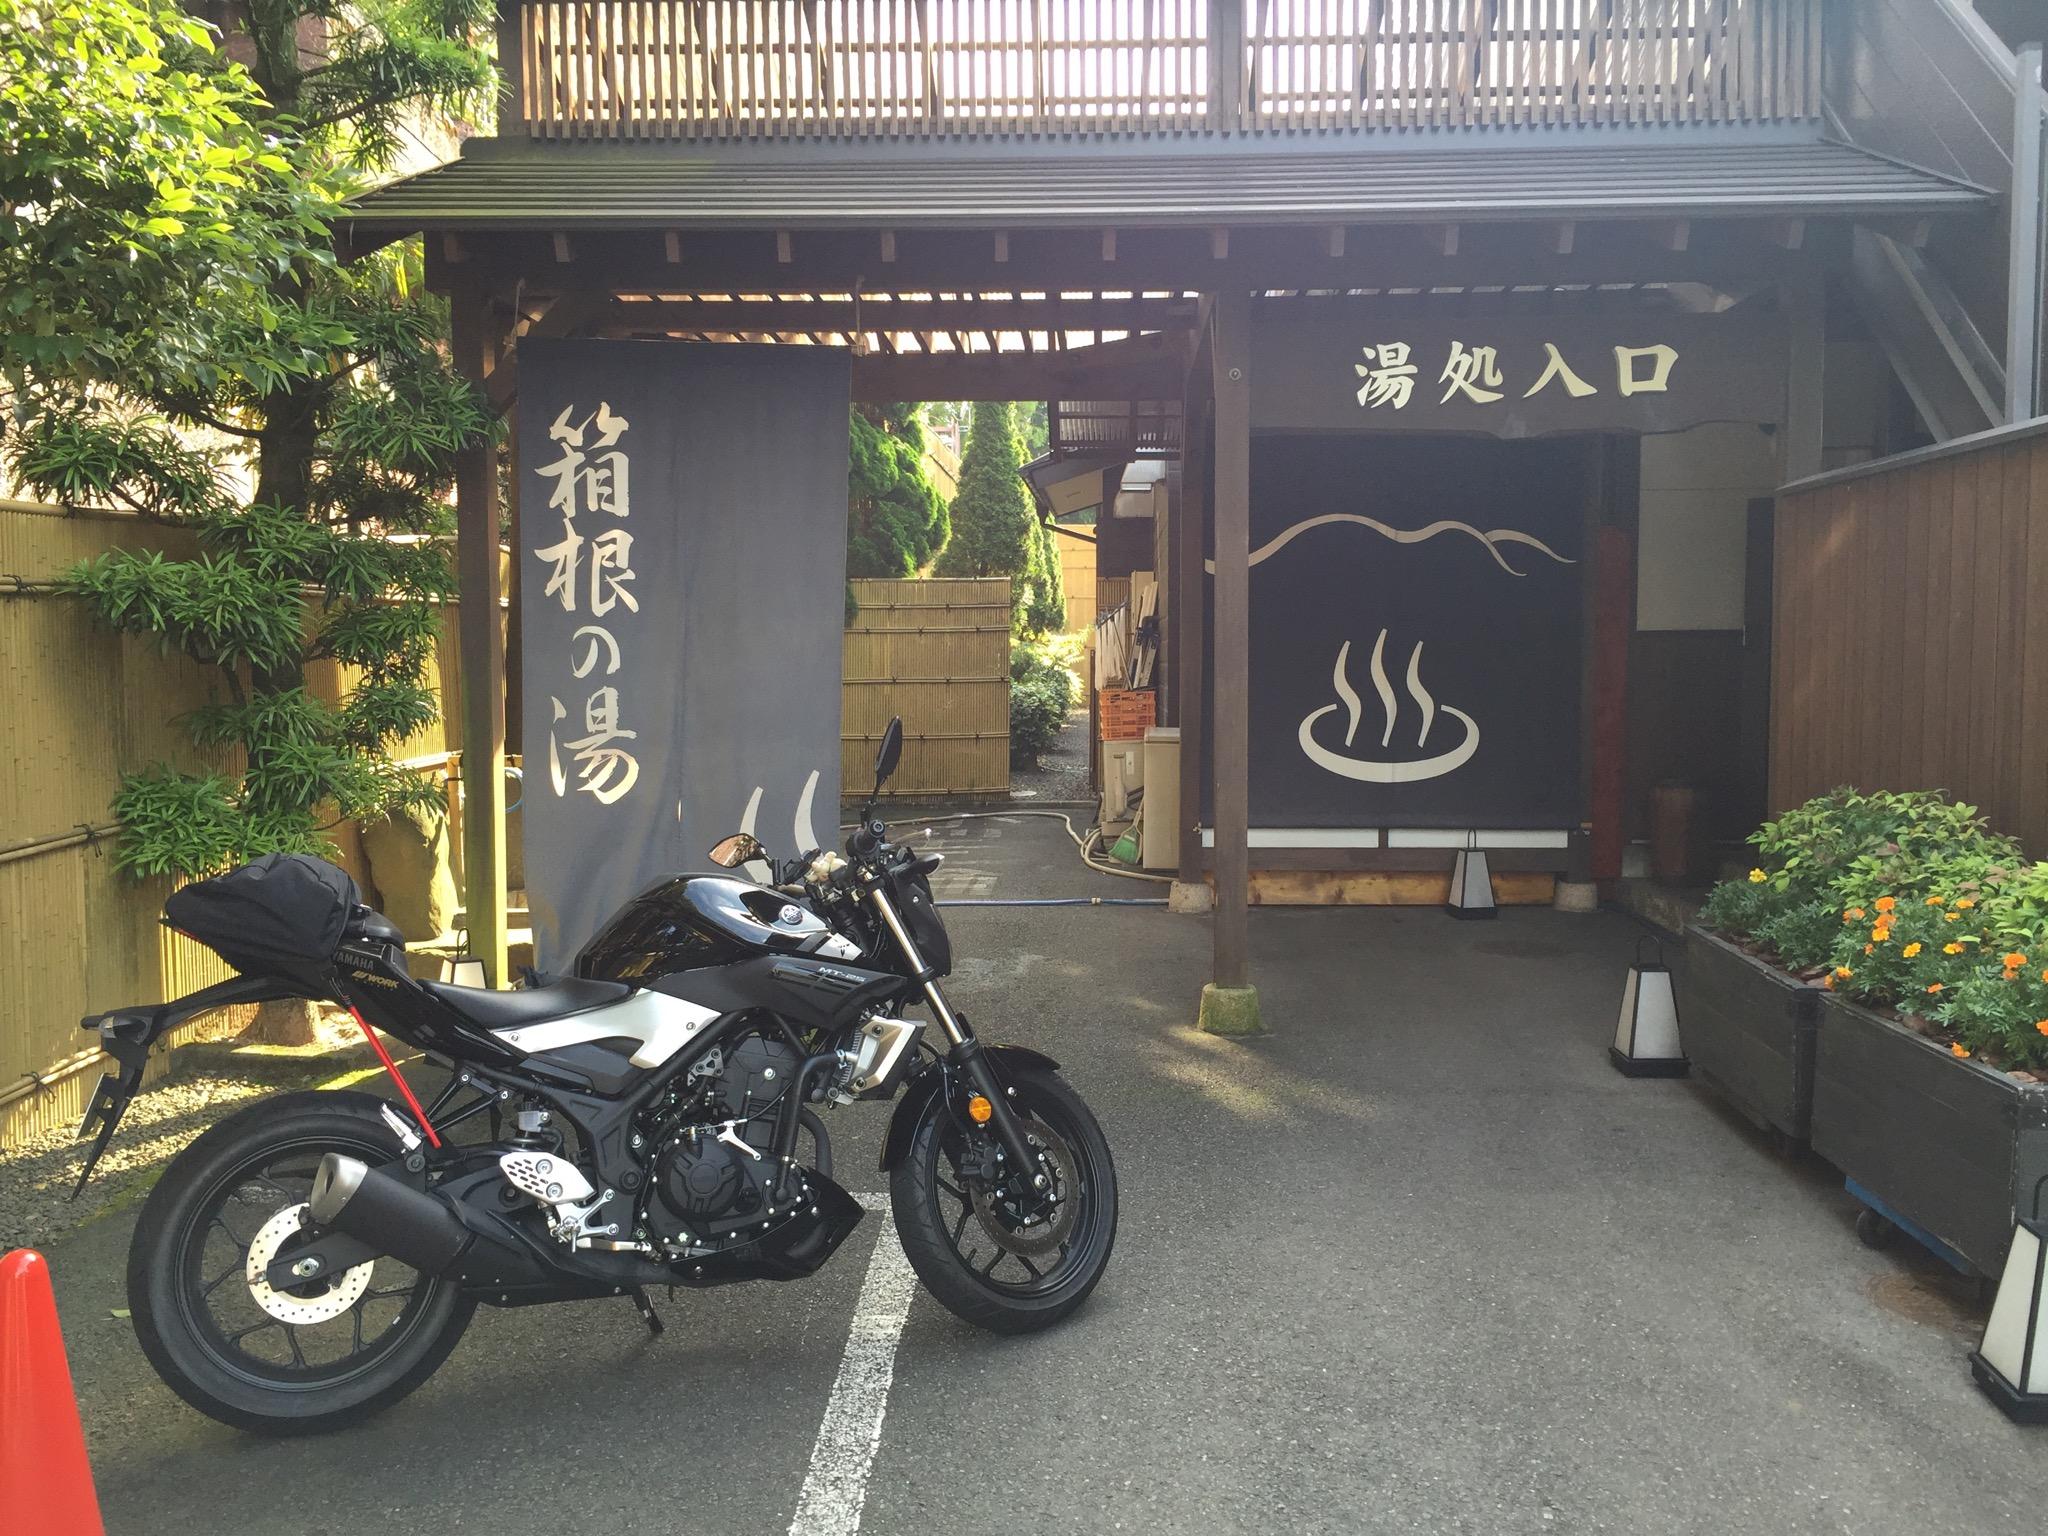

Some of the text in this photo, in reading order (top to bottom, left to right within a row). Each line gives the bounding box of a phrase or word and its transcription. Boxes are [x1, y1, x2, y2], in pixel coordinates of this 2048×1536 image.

[1354, 340, 1679, 410] 湯処入口
[533, 400, 640, 806] 箱根の湯
[367, 974, 400, 989] WORK
